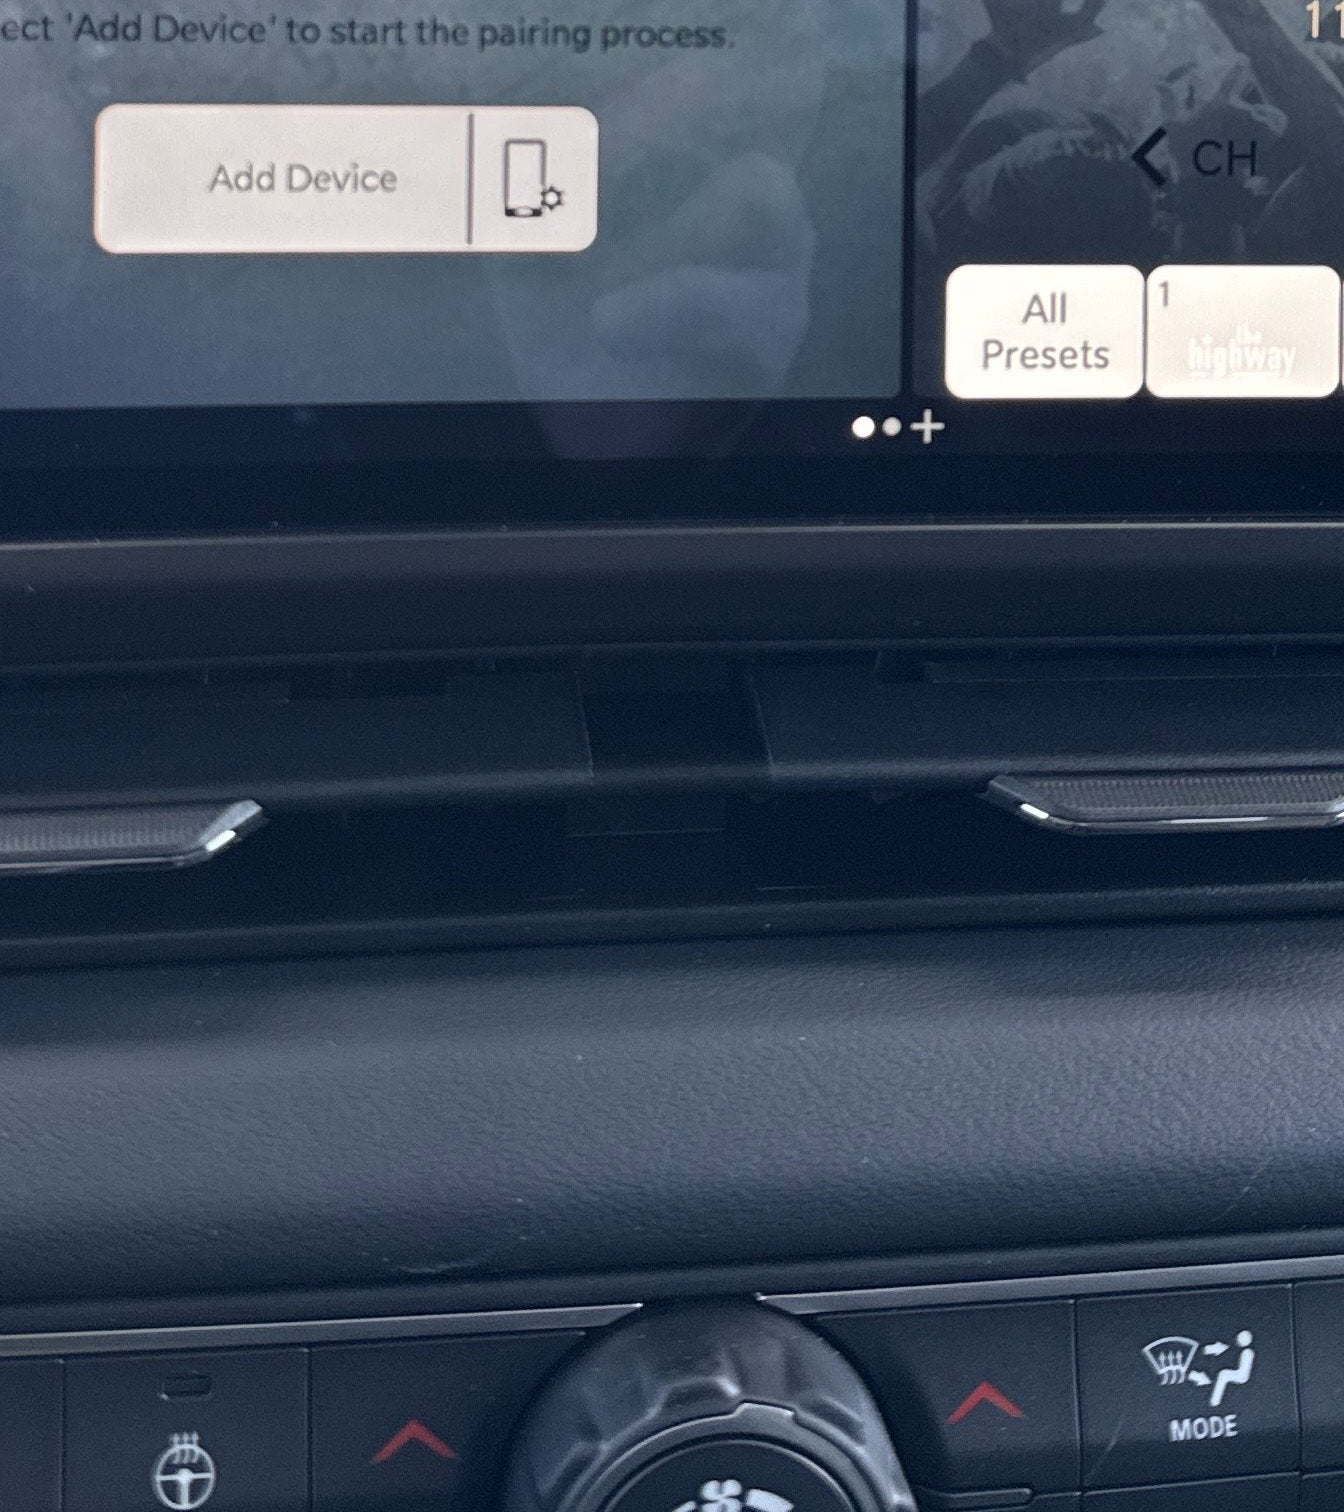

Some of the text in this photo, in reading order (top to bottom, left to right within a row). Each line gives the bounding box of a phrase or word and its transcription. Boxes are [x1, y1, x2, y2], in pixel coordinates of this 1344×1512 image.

[65, 11, 142, 44] 'Add
[154, 12, 277, 45] Device'
[286, 16, 321, 46] to
[330, 16, 407, 47] start
[416, 15, 469, 47] the
[479, 16, 592, 53] pairing
[601, 22, 736, 54] process.
[1193, 140, 1258, 176] CH
[208, 162, 398, 194] Add Device
[1021, 292, 1067, 325] All
[1158, 281, 1170, 308] 1
[982, 340, 1110, 371] Presets
[1169, 1414, 1239, 1442] MODE
